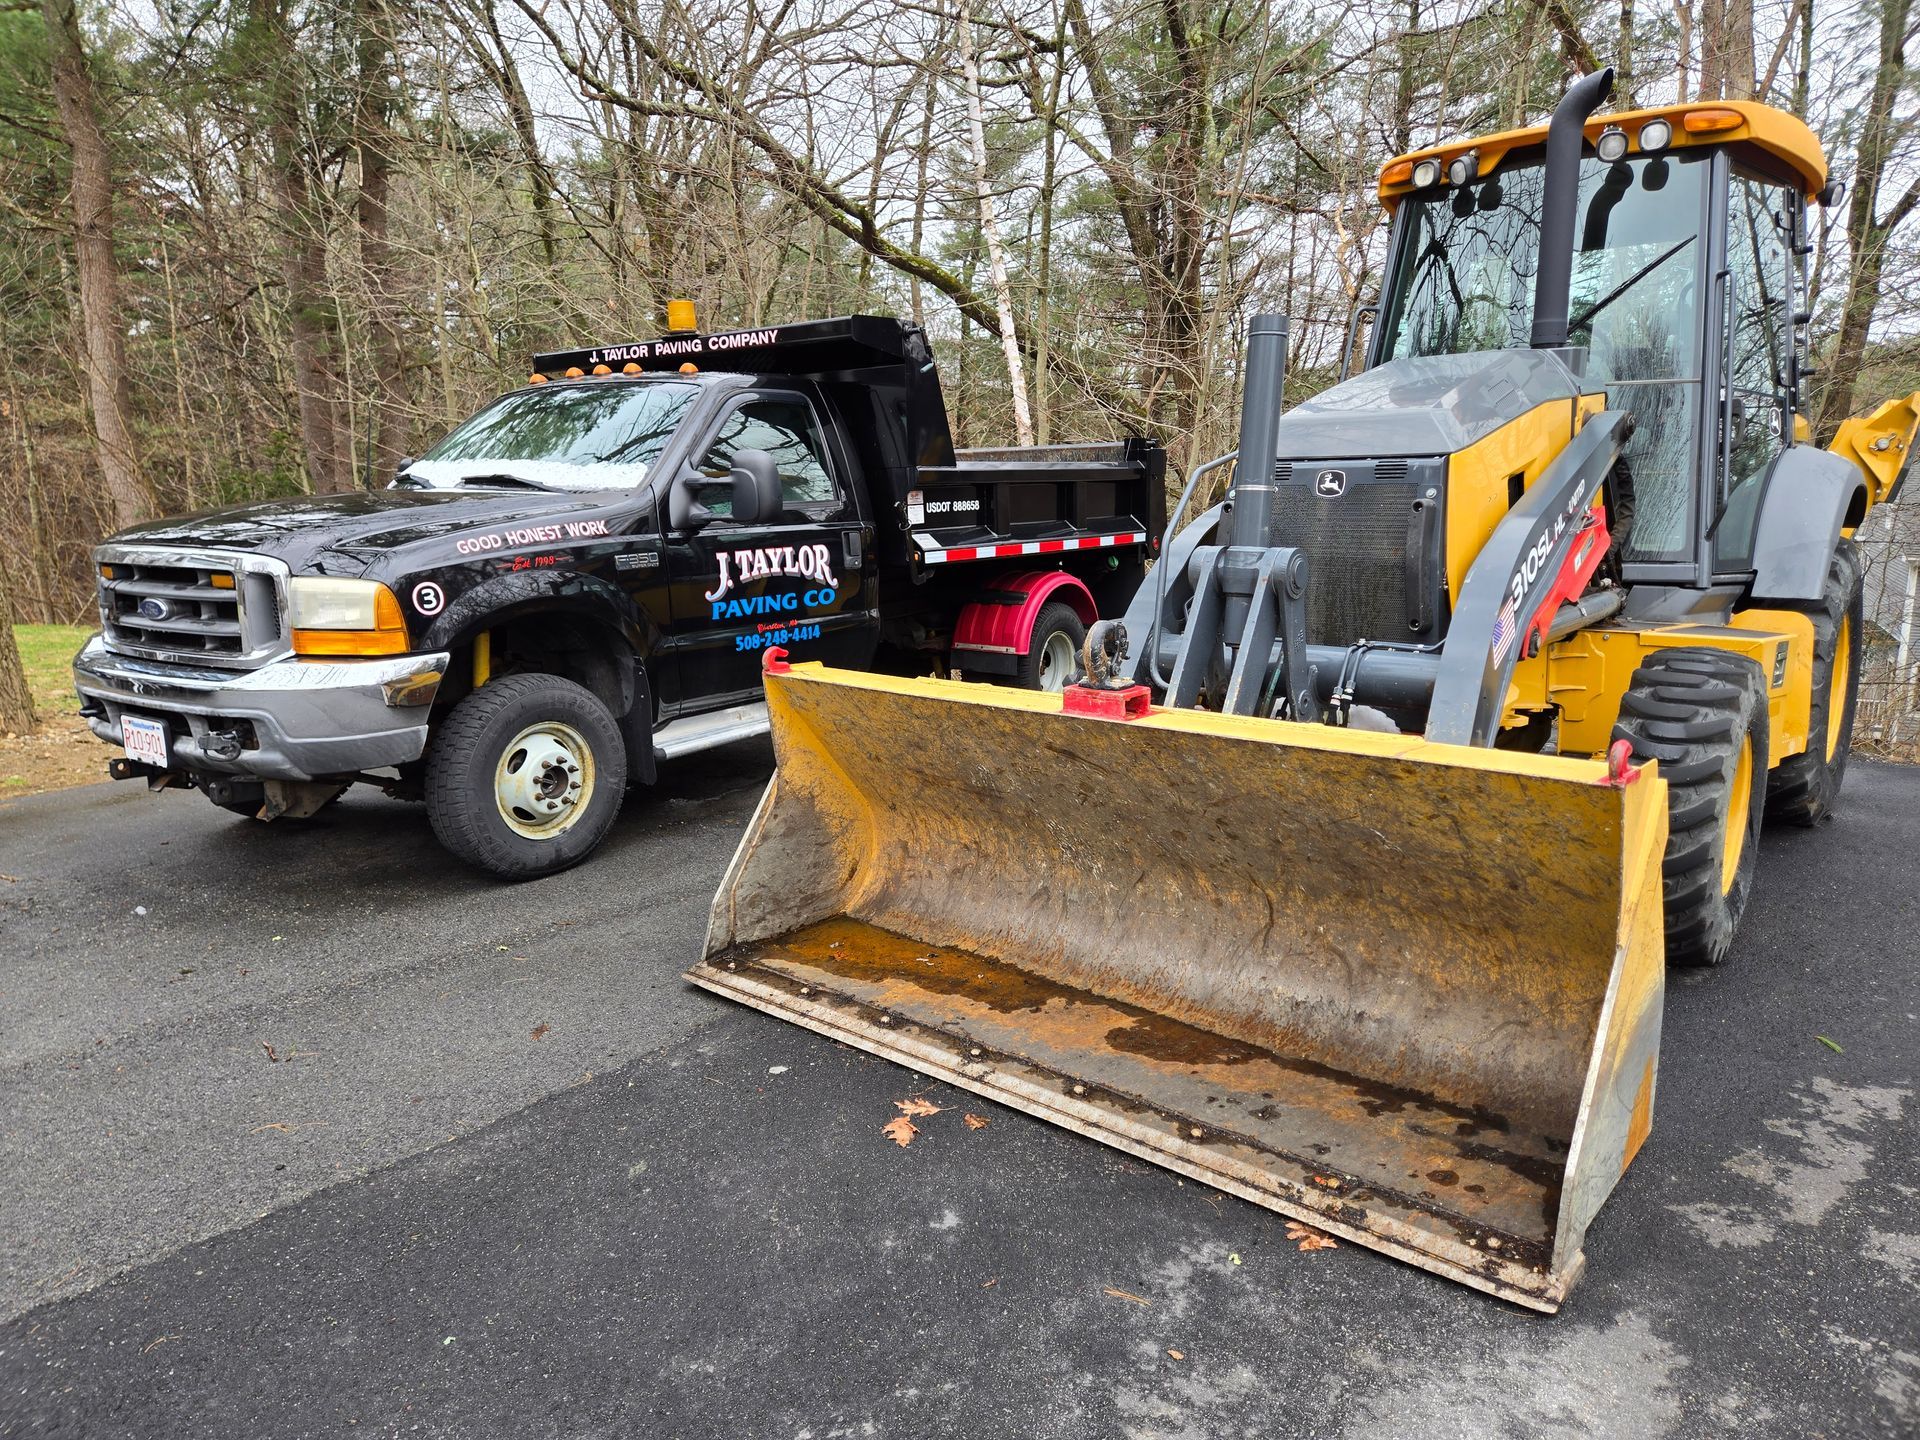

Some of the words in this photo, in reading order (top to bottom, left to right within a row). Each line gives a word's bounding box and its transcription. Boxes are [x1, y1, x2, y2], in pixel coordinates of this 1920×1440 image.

[589, 350, 599, 363] J.
[602, 345, 649, 362] TAYLOR
[655, 339, 702, 356] PAVING
[708, 329, 779, 350] COMPANY
[926, 501, 951, 513] USDOT
[952, 500, 980, 512] 888658
[456, 533, 502, 555] GOOD
[505, 524, 563, 547] HONEST
[564, 520, 609, 538] WORK
[535, 555, 555, 568] 1998
[705, 552, 734, 602] J.
[735, 544, 839, 589] TAYLOR
[1511, 528, 1554, 612] 310SL
[1554, 513, 1566, 541] HL
[420, 588, 438, 609] 3
[711, 592, 798, 620] PAVING
[803, 588, 836, 608] CO
[735, 624, 821, 652] 508-248-4414
